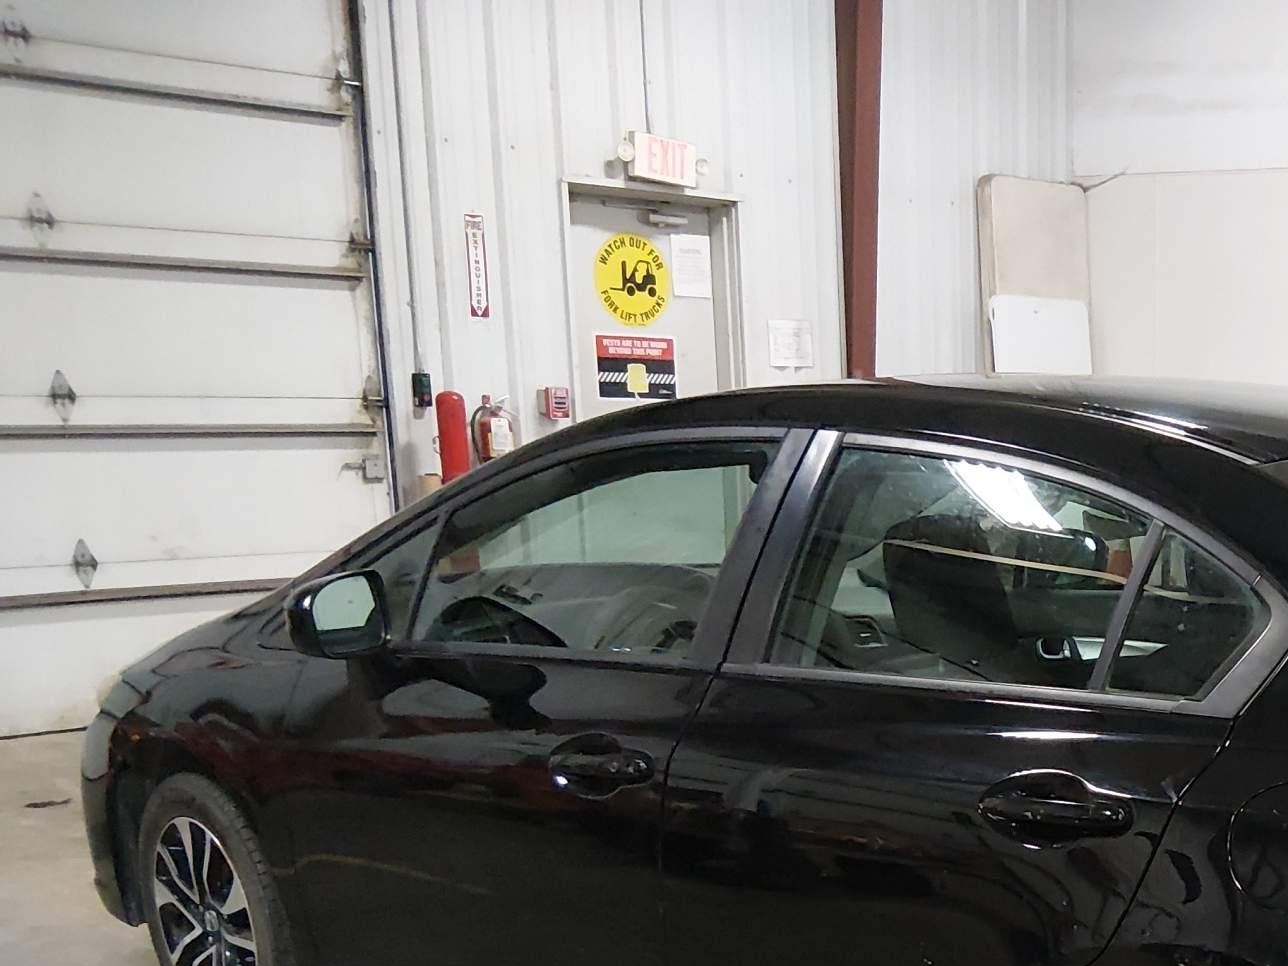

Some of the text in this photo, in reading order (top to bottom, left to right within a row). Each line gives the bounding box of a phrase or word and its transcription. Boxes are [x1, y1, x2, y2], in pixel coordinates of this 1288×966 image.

[647, 136, 687, 180] EXIT
[471, 232, 482, 311] EXTINGUISHER
[599, 237, 664, 271] WATCH OUT FOR
[600, 289, 665, 323] FORK LIFT TRUCKS
